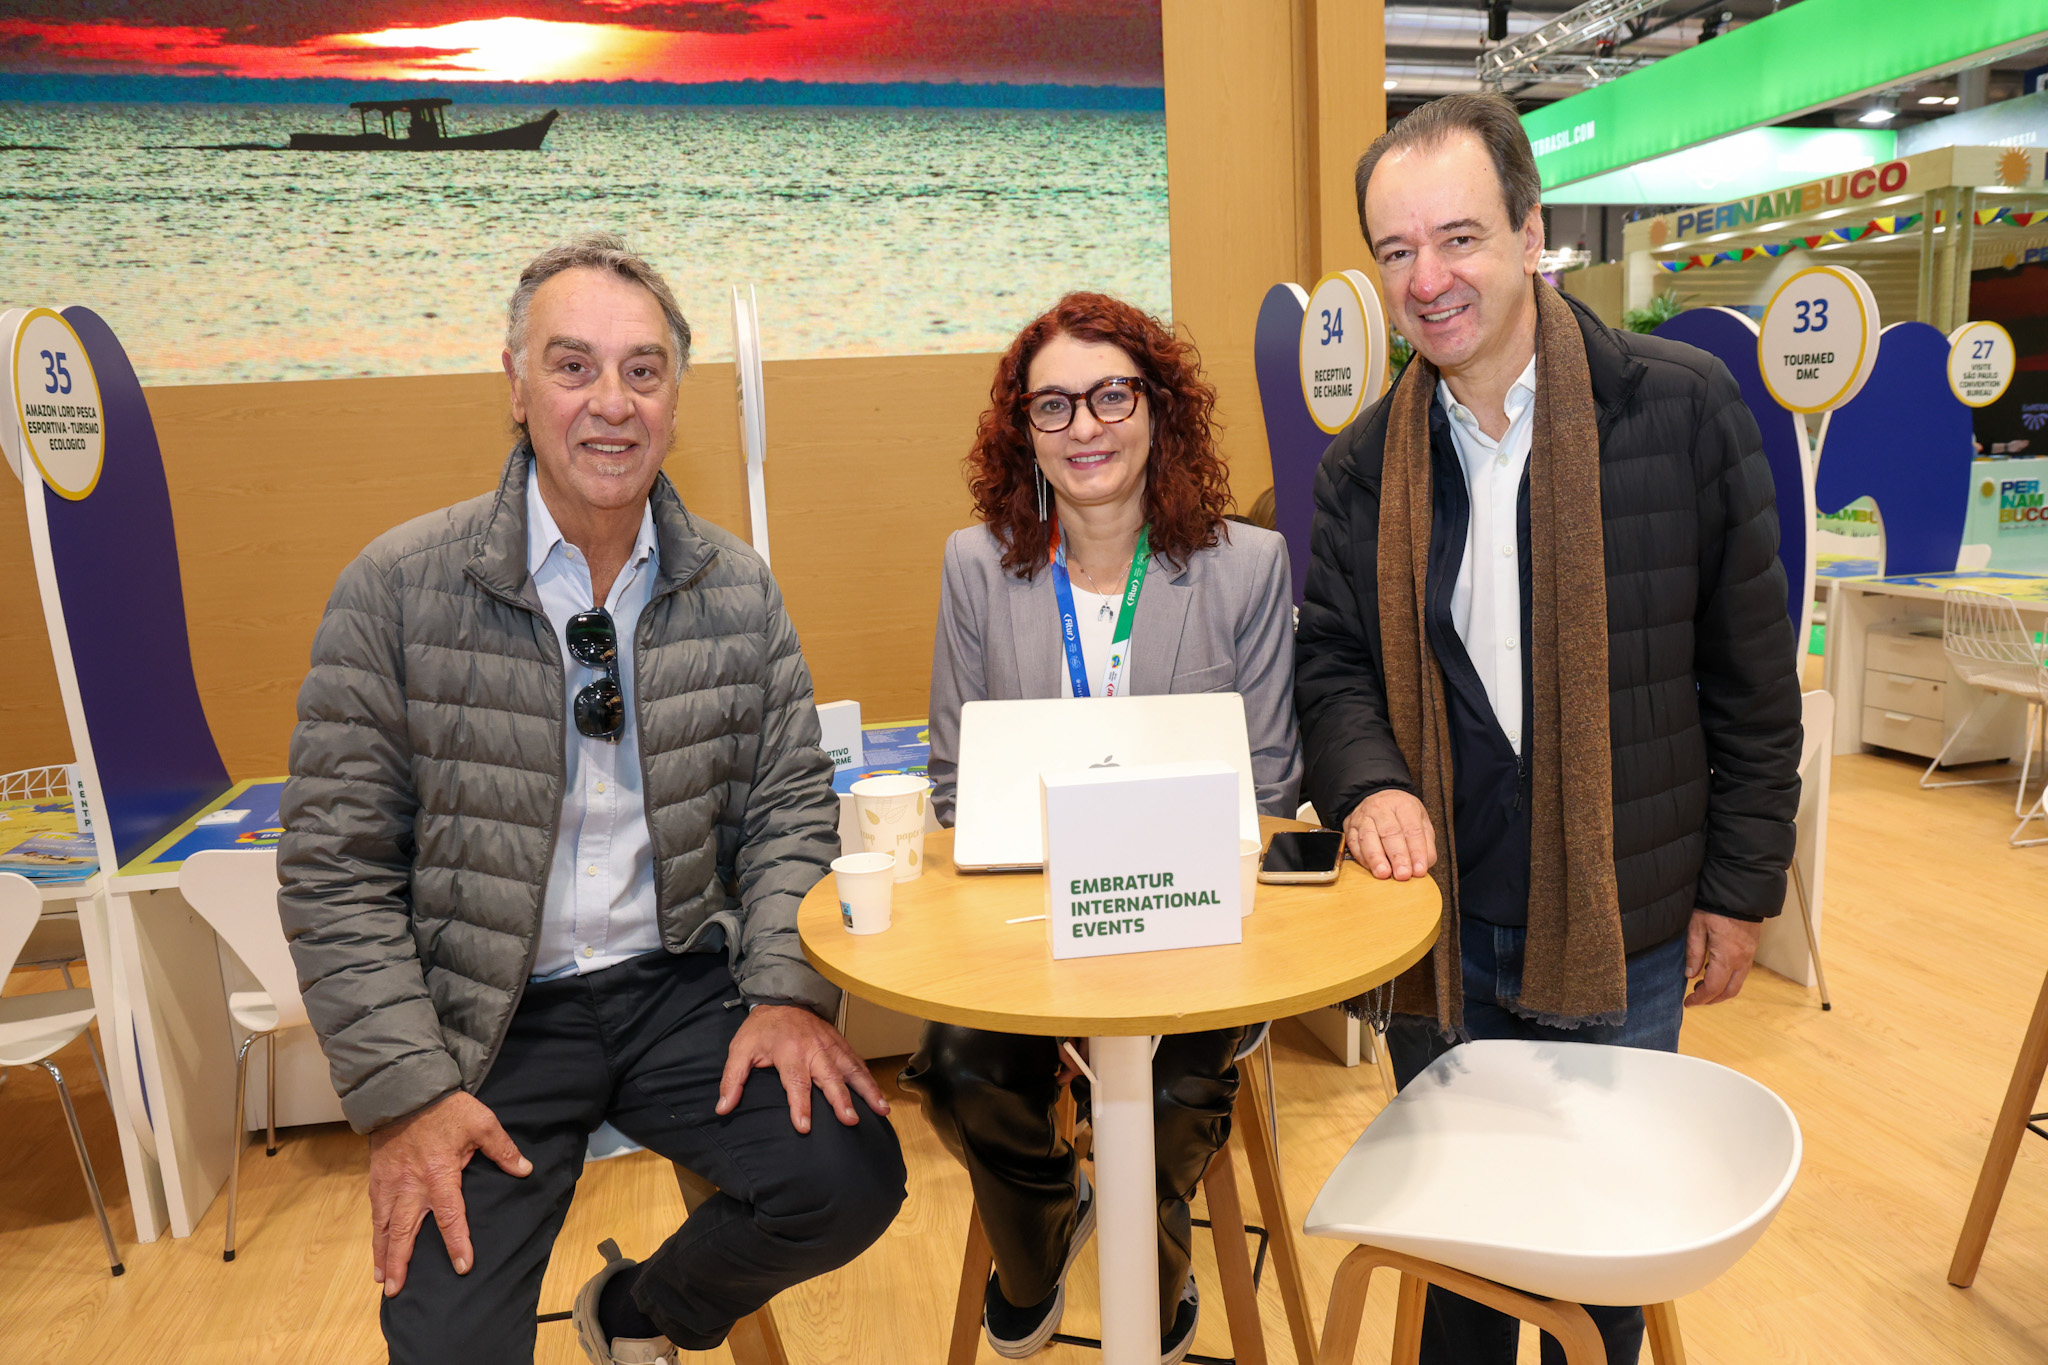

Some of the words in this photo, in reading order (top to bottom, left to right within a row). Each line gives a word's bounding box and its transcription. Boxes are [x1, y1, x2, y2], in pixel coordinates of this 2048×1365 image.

[1531, 120, 1595, 157] TBRASIL.COM
[1677, 161, 1909, 238] PERNAMBUCO
[1793, 298, 1829, 333] 33
[1320, 307, 1344, 346] 34
[1972, 340, 1994, 359] 27
[1783, 352, 1835, 366] TOURMED
[1971, 363, 1992, 371] VISITE
[40, 349, 72, 395] 35
[1314, 366, 1351, 382] RECEPTIVO
[1796, 368, 1820, 380] DMC
[1978, 371, 1998, 379] PAULO
[1313, 385, 1322, 399] DE
[1323, 383, 1353, 398] CHARME
[1959, 380, 2000, 388] CONVENTION
[1966, 389, 1992, 397] BUREAU
[25, 403, 57, 417] AMAZON
[58, 404, 76, 418] LORD
[76, 406, 98, 419] PESCA
[27, 421, 67, 434] ESPORTIVA
[70, 422, 99, 434] TURISMO
[49, 438, 86, 451] ECOLOGICO
[2001, 479, 2039, 495] PER
[2000, 493, 2044, 509] NAM
[1999, 506, 2048, 523] BUCO
[896, 829, 919, 847] paper
[1070, 872, 1175, 895] EMBRATUR
[1071, 889, 1221, 917] INTERNATIONAL
[1072, 917, 1145, 938] EVENTS
